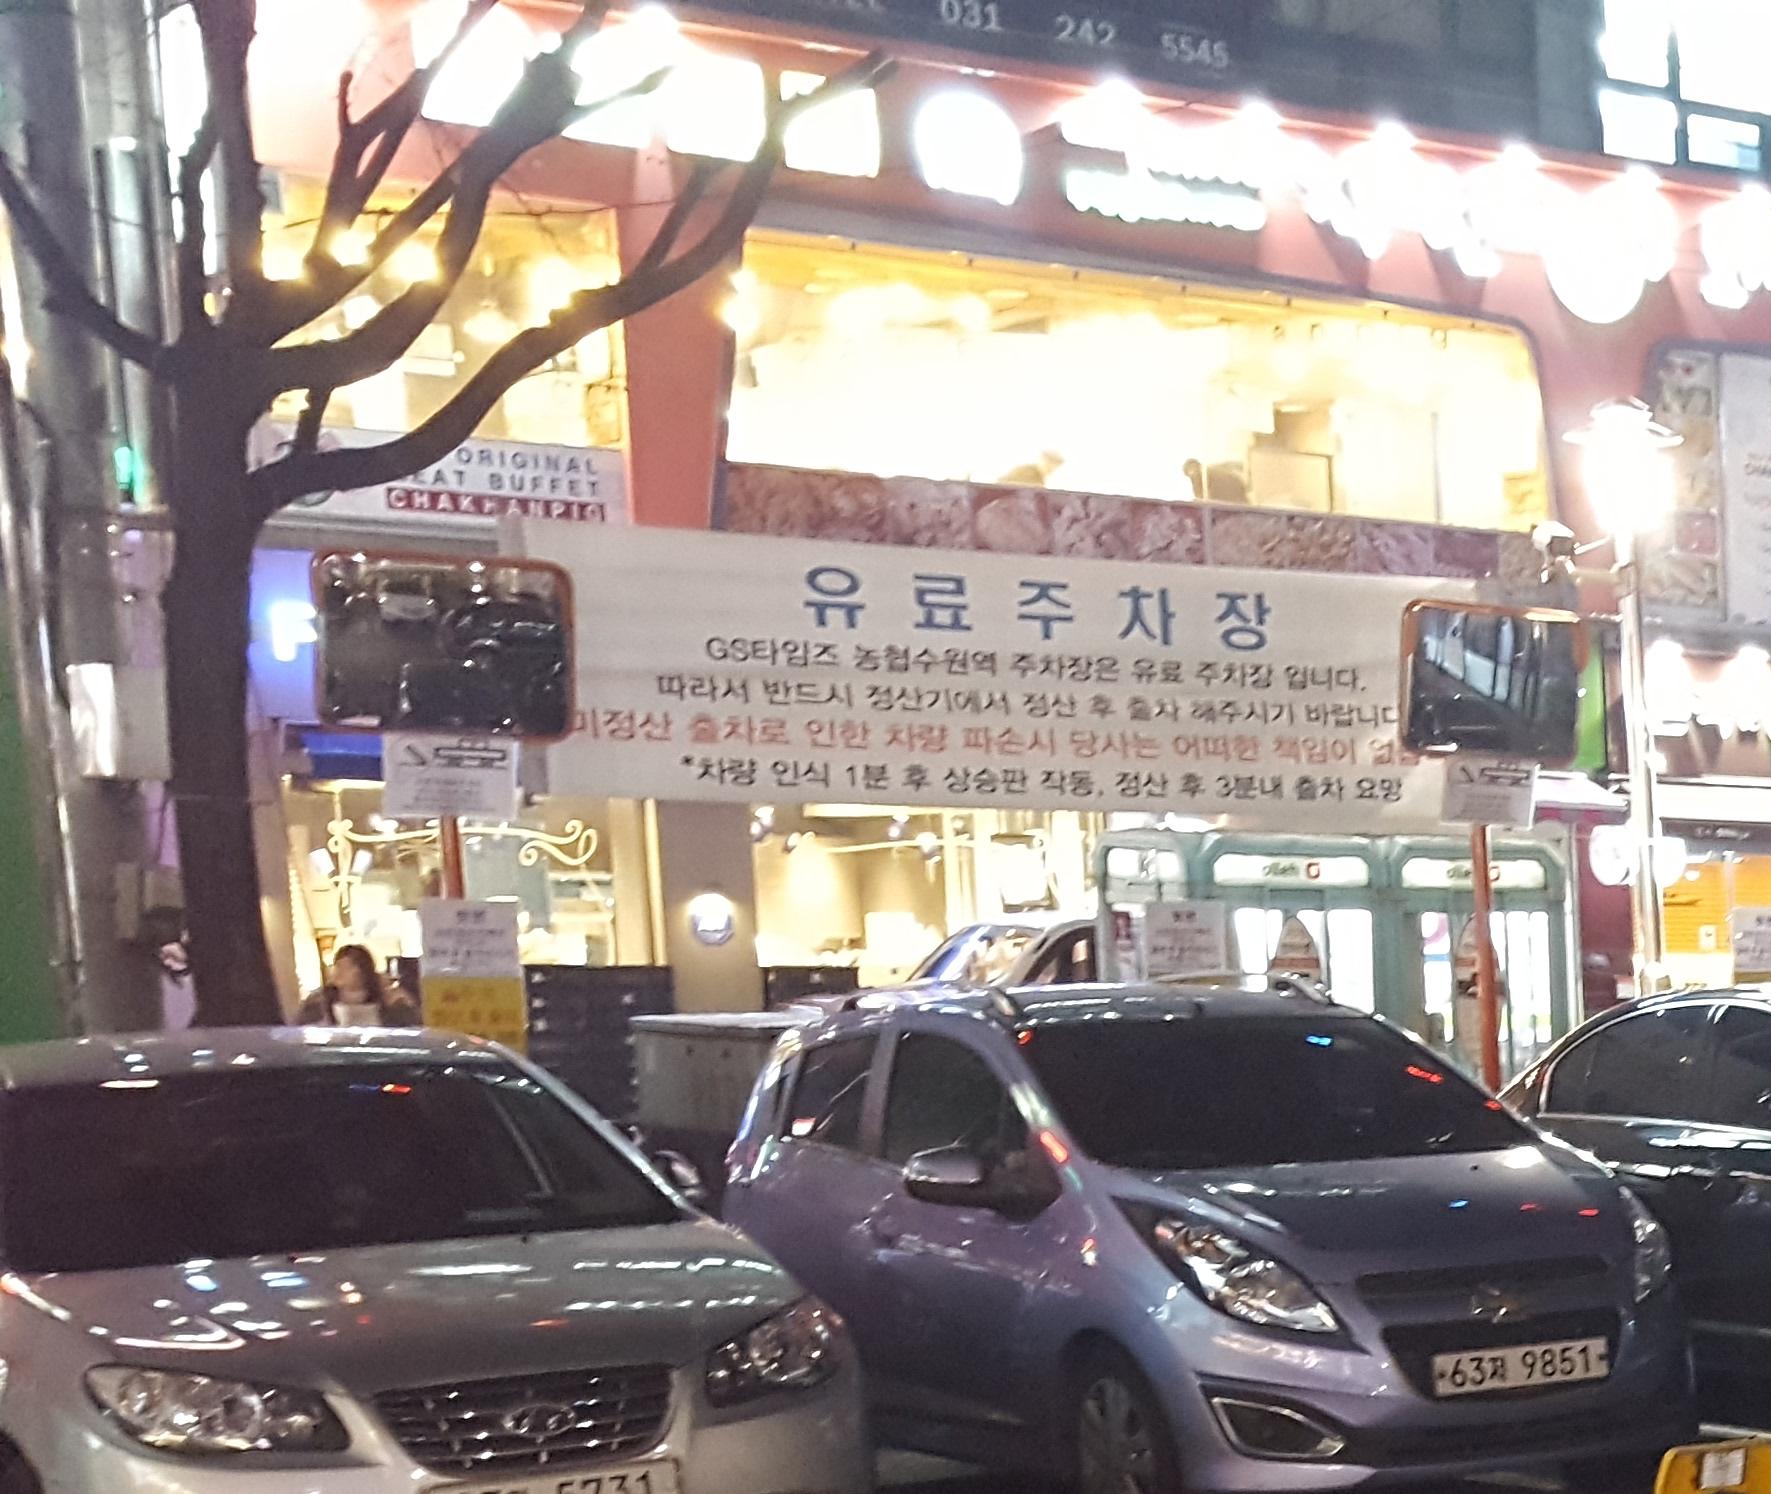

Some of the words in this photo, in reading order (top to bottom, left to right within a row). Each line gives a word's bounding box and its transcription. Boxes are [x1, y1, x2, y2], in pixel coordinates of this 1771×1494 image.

[1055, 15, 1117, 47] 242
[1160, 33, 1231, 68] 5545
[456, 446, 600, 476] ORIGINAL
[488, 471, 600, 498] BUFFET
[705, 637, 841, 668] GS타임즈
[854, 645, 998, 676] 농협수원역
[1009, 653, 1121, 683] 주차장은
[1131, 658, 1184, 684] 유료
[1195, 660, 1273, 689] 주차장
[1286, 665, 1367, 692] 입니다.
[657, 675, 751, 703] 따라서
[764, 678, 854, 707] 반드시
[866, 684, 1010, 715] 정산기에서
[1024, 692, 1077, 718] 정산
[1087, 694, 1117, 718] 후
[1128, 698, 1179, 723] 출차
[1192, 701, 1295, 727] 해주시기
[688, 712, 790, 747] 출차로
[804, 718, 870, 751] 인한
[886, 722, 950, 753] 차량
[963, 726, 1057, 757] 파손시
[1069, 729, 1162, 759] 당사는
[1173, 735, 1262, 763] 어떠한
[1273, 736, 1358, 765] 책임이
[772, 759, 831, 788] 인식
[846, 764, 889, 790] 1분
[903, 765, 931, 792] 후
[943, 766, 1027, 794] 상승판
[1115, 771, 1168, 798] 정산
[1179, 772, 1206, 799] 후
[1216, 774, 1284, 800] 3분내
[1294, 777, 1344, 801] 출차
[1355, 777, 1403, 802] 요망
[1521, 1345, 1591, 1380] 9851
